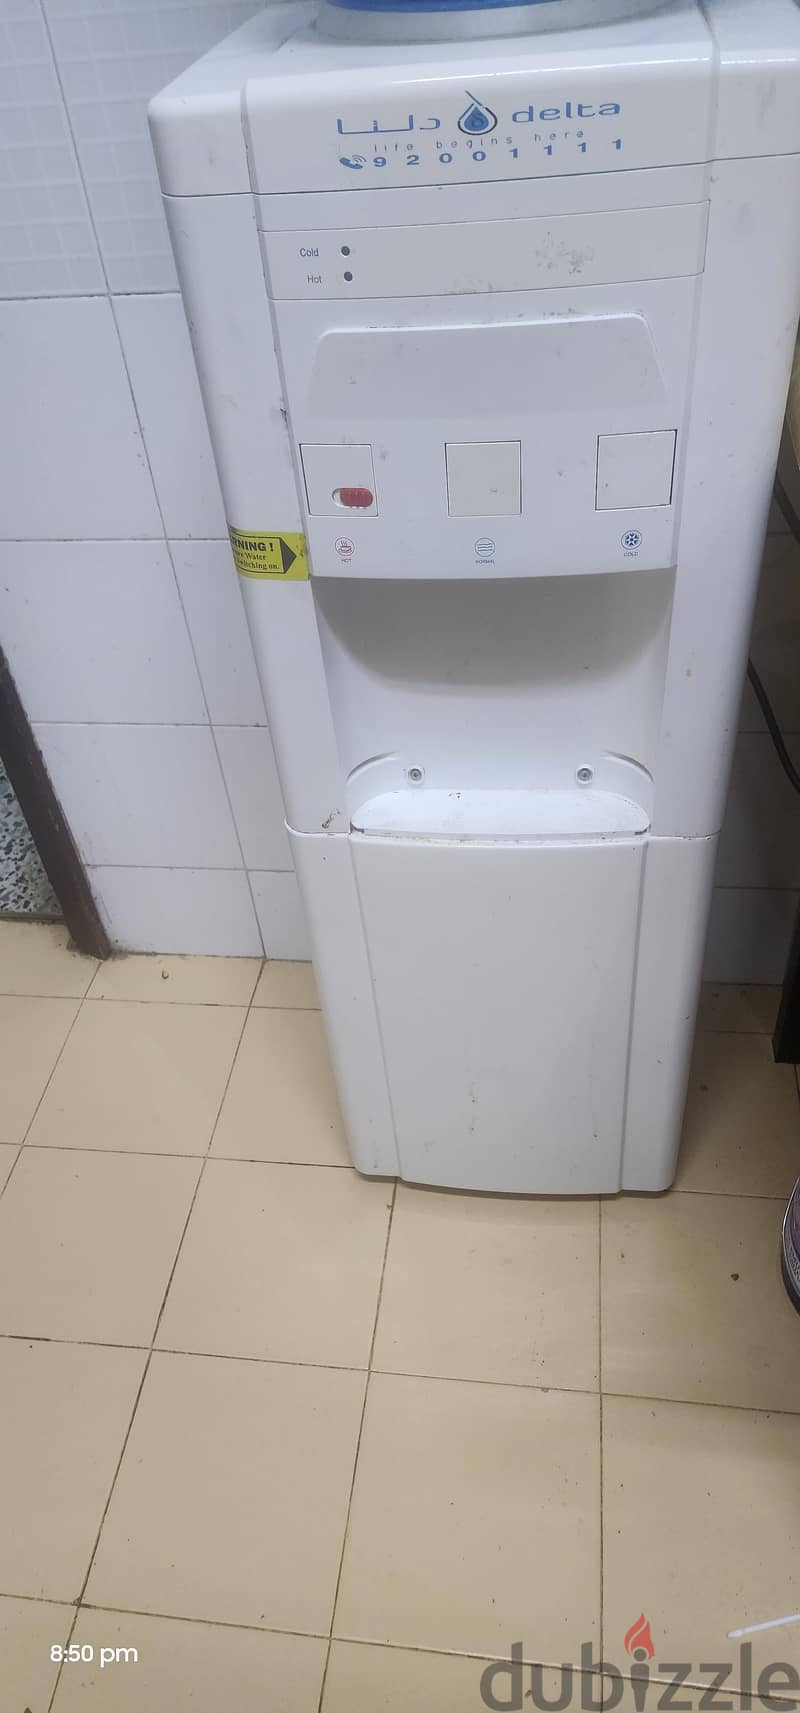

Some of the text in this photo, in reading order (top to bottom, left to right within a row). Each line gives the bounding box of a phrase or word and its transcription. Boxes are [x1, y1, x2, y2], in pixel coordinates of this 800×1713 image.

[511, 101, 621, 123] delta
[436, 136, 513, 149] begins
[534, 130, 584, 142] here
[299, 247, 320, 257] Cold
[307, 274, 322, 284] Hot
[245, 551, 266, 561] Water
